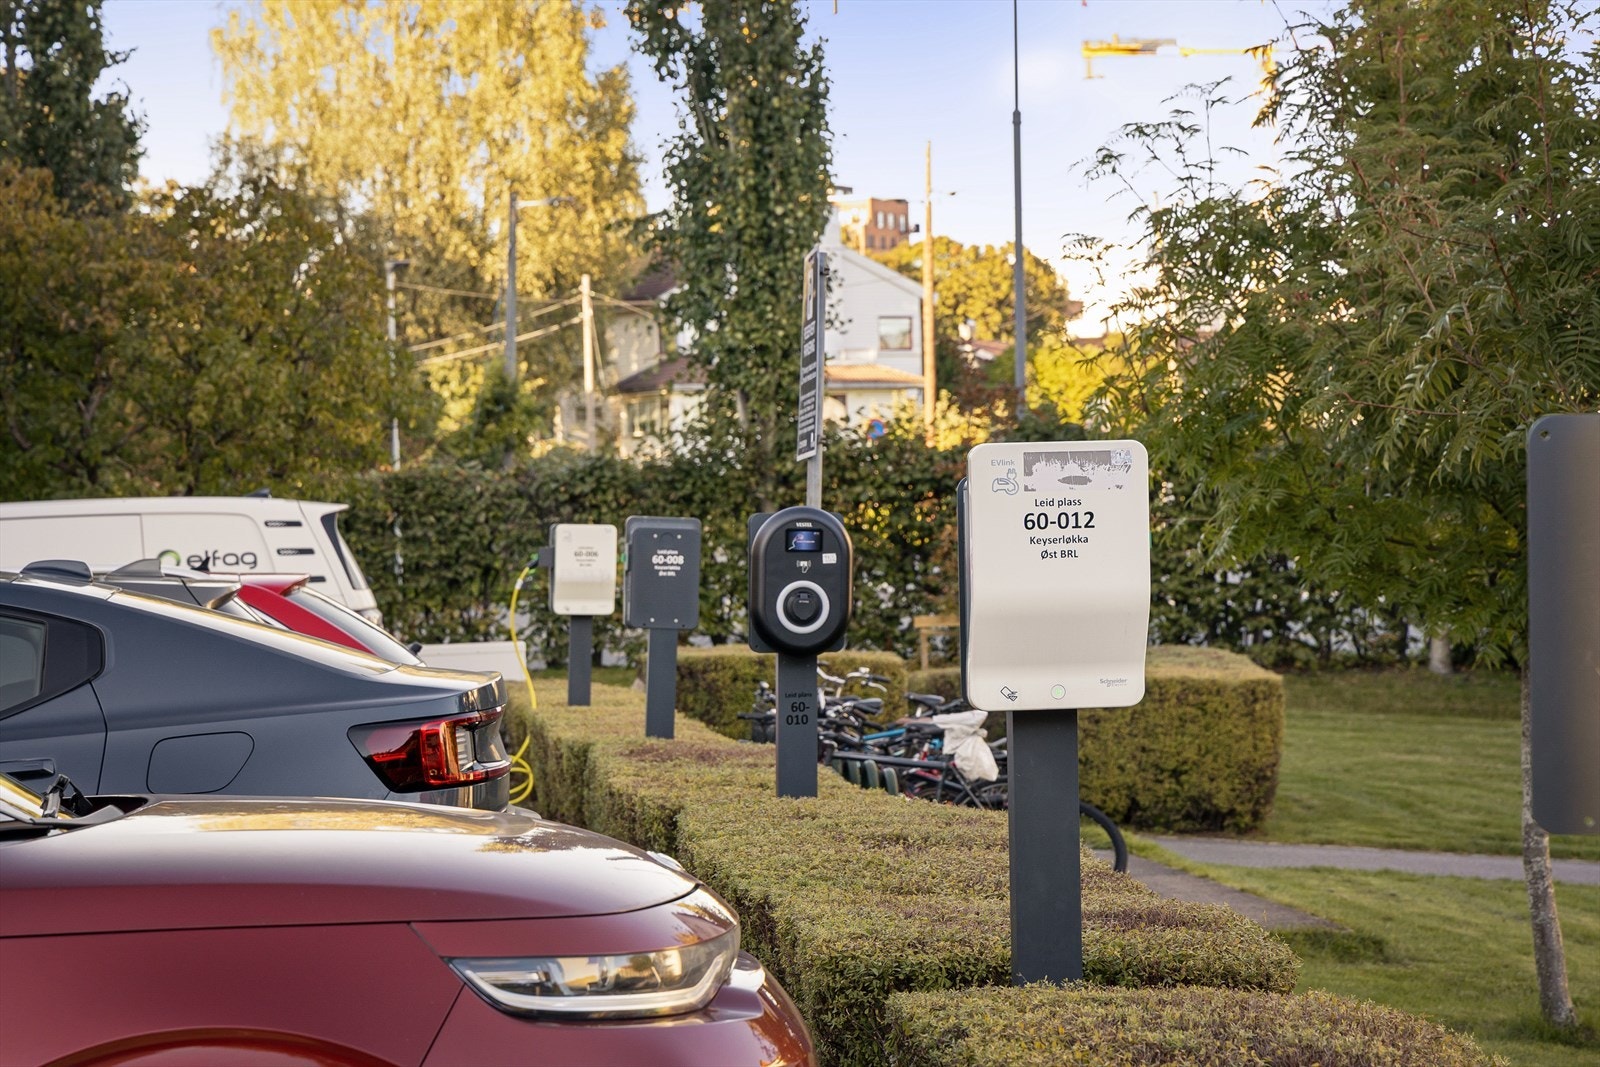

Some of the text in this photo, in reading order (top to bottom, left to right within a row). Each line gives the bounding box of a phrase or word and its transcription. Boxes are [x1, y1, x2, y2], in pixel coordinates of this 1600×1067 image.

[990, 459, 1016, 467] EVlink
[1034, 498, 1082, 508] Leid plass
[1023, 511, 1095, 530] 60-012
[1029, 535, 1089, 547] Keyserløkka
[186, 550, 258, 569] elfag
[652, 555, 684, 565] 60-008
[1040, 549, 1079, 560] Øst BRL
[791, 701, 810, 713] 60-
[786, 714, 809, 726] 010
